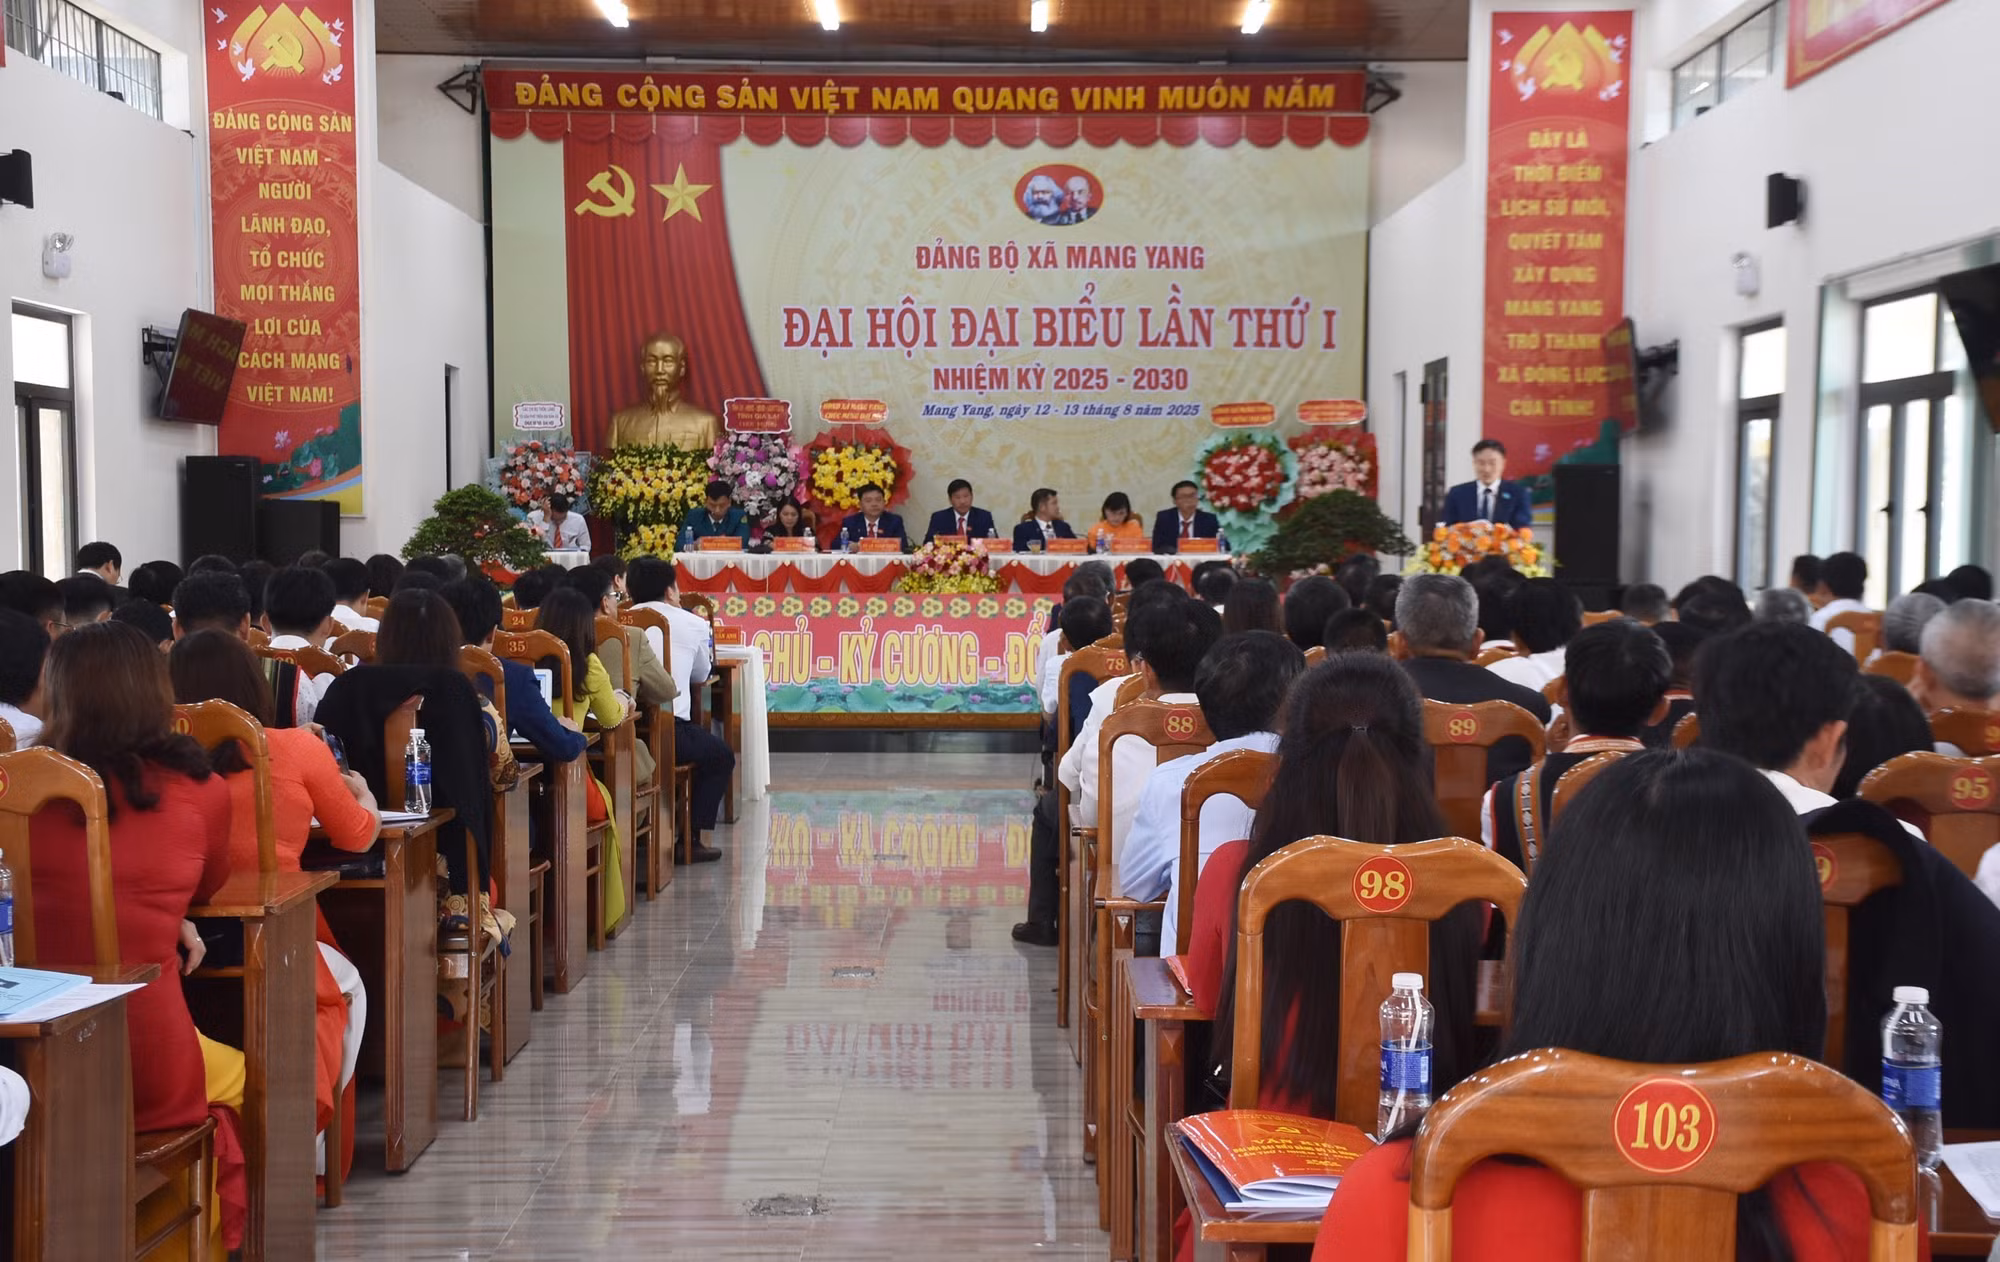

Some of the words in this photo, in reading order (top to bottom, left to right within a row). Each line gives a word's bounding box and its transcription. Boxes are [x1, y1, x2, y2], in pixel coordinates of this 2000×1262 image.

[515, 74, 602, 107] ĐẢNG
[617, 76, 705, 112] CỘNG
[717, 78, 778, 110] SẢN
[789, 80, 860, 115] VIỆT
[872, 86, 939, 110] NAM
[952, 86, 1058, 113] QUANG
[1071, 86, 1145, 111] VINH
[1158, 77, 1250, 110] MUÔN
[1264, 78, 1335, 108] NĂM
[213, 108, 260, 130] ĐẢNG
[266, 110, 313, 135] CỘNG
[319, 111, 352, 132] SẢN
[236, 144, 274, 168] VIỆT
[280, 149, 318, 166] NAM
[258, 179, 312, 200] NGƯỜI
[241, 213, 285, 233] LÃNH
[291, 217, 331, 238] ĐẠO,
[250, 243, 271, 267] TỔ
[277, 247, 324, 268] CHỨC
[915, 237, 980, 269] ĐẢNG
[988, 240, 1019, 274] BỘ
[1027, 240, 1058, 269] XÃ
[1066, 246, 1136, 269] MANG
[1144, 246, 1204, 270] YANG
[240, 284, 273, 304] MỌI
[279, 279, 335, 302] THẮNG
[783, 307, 853, 358] ĐẠI
[866, 295, 937, 358] HỘI
[951, 307, 1019, 357] ĐẠI
[1032, 281, 1125, 348] BIỂU
[1138, 283, 1214, 348] LẦN
[1228, 296, 1310, 349] THỨ
[1323, 309, 1336, 349] I
[1504, 299, 1554, 316] MANG
[1558, 299, 1603, 316] YANG
[255, 316, 281, 338] LỢI
[287, 314, 322, 336] CỦA
[238, 348, 284, 369] CÁCH
[291, 353, 340, 373] MẠNG
[933, 363, 1009, 395] NHIỆM
[1017, 363, 1046, 390] KỲ
[1053, 368, 1108, 390] 2025
[1133, 368, 1188, 390] 2030
[247, 382, 284, 406] VIỆT
[290, 386, 334, 403] NAM!
[922, 404, 958, 418] Mang
[962, 404, 995, 418] Yang,
[999, 404, 1028, 418] ngày
[1035, 404, 1051, 415] 12
[1064, 404, 1079, 415] 13
[1082, 404, 1121, 418] tháng
[1123, 404, 1132, 415] 8
[1135, 404, 1163, 416] năm
[1167, 405, 1200, 416] 2025
[512, 616, 525, 625] 24
[620, 615, 634, 625] 25
[509, 641, 526, 652] 35
[753, 616, 811, 684] CHỦ
[839, 616, 878, 684] KỶ
[882, 624, 979, 685] CƯƠNG
[1004, 610, 1047, 685] ĐỔ
[1106, 658, 1125, 671] 78
[1167, 715, 1194, 733] 88
[1449, 718, 1477, 736] 89
[1953, 776, 1990, 800] 95
[1359, 870, 1406, 900] 98
[1630, 1100, 1701, 1153] 103
